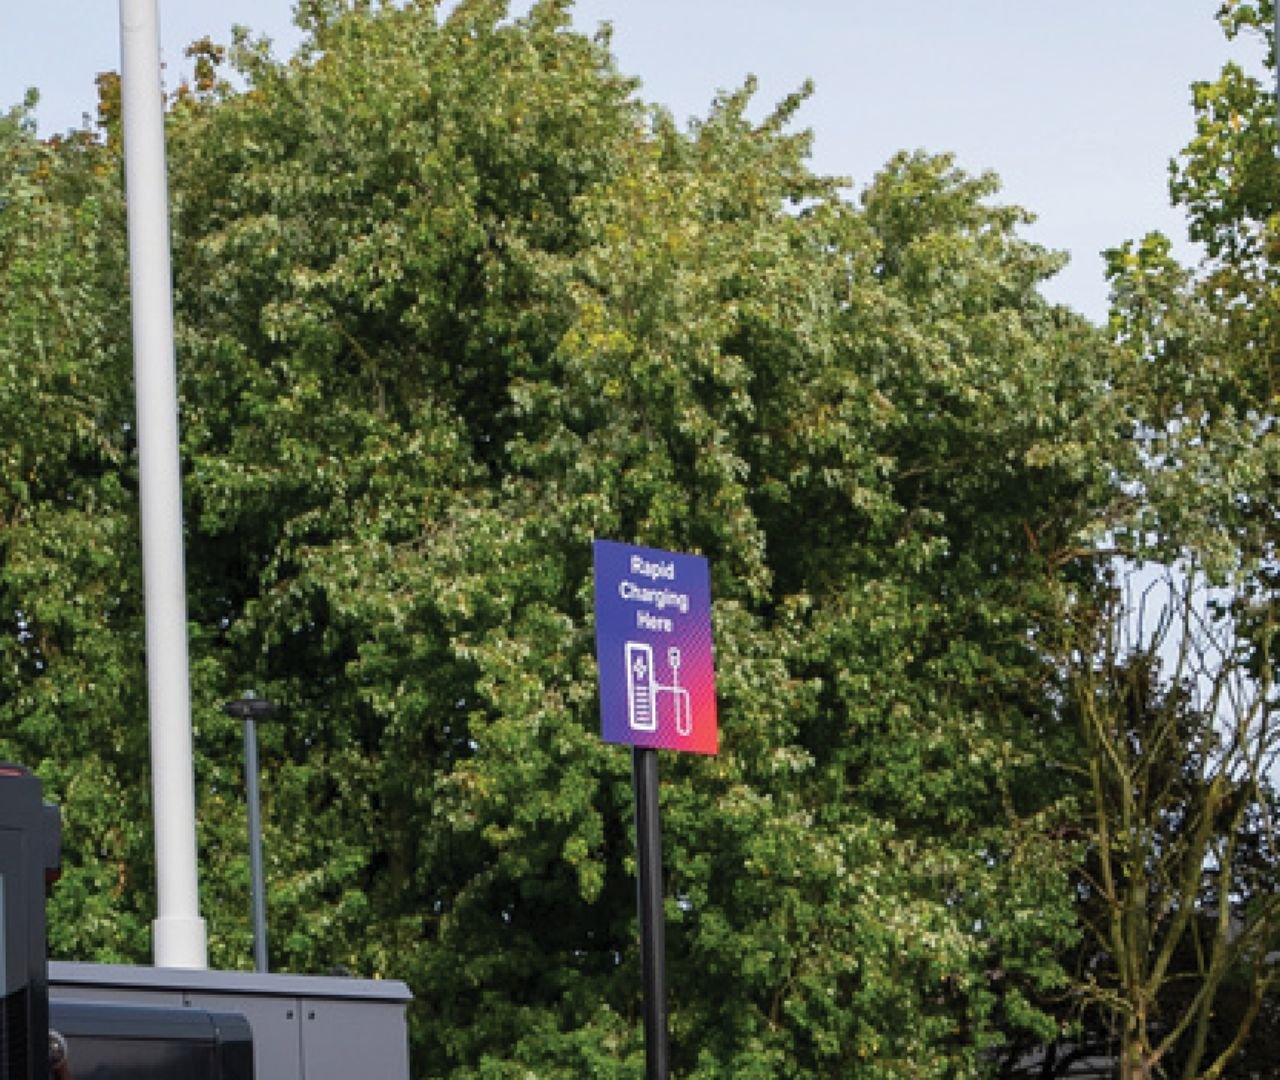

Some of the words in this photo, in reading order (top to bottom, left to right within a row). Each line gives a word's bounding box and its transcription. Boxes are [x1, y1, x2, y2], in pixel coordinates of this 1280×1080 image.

[630, 554, 674, 580] Rapid
[619, 581, 690, 614] Charging
[636, 609, 673, 632] Here
